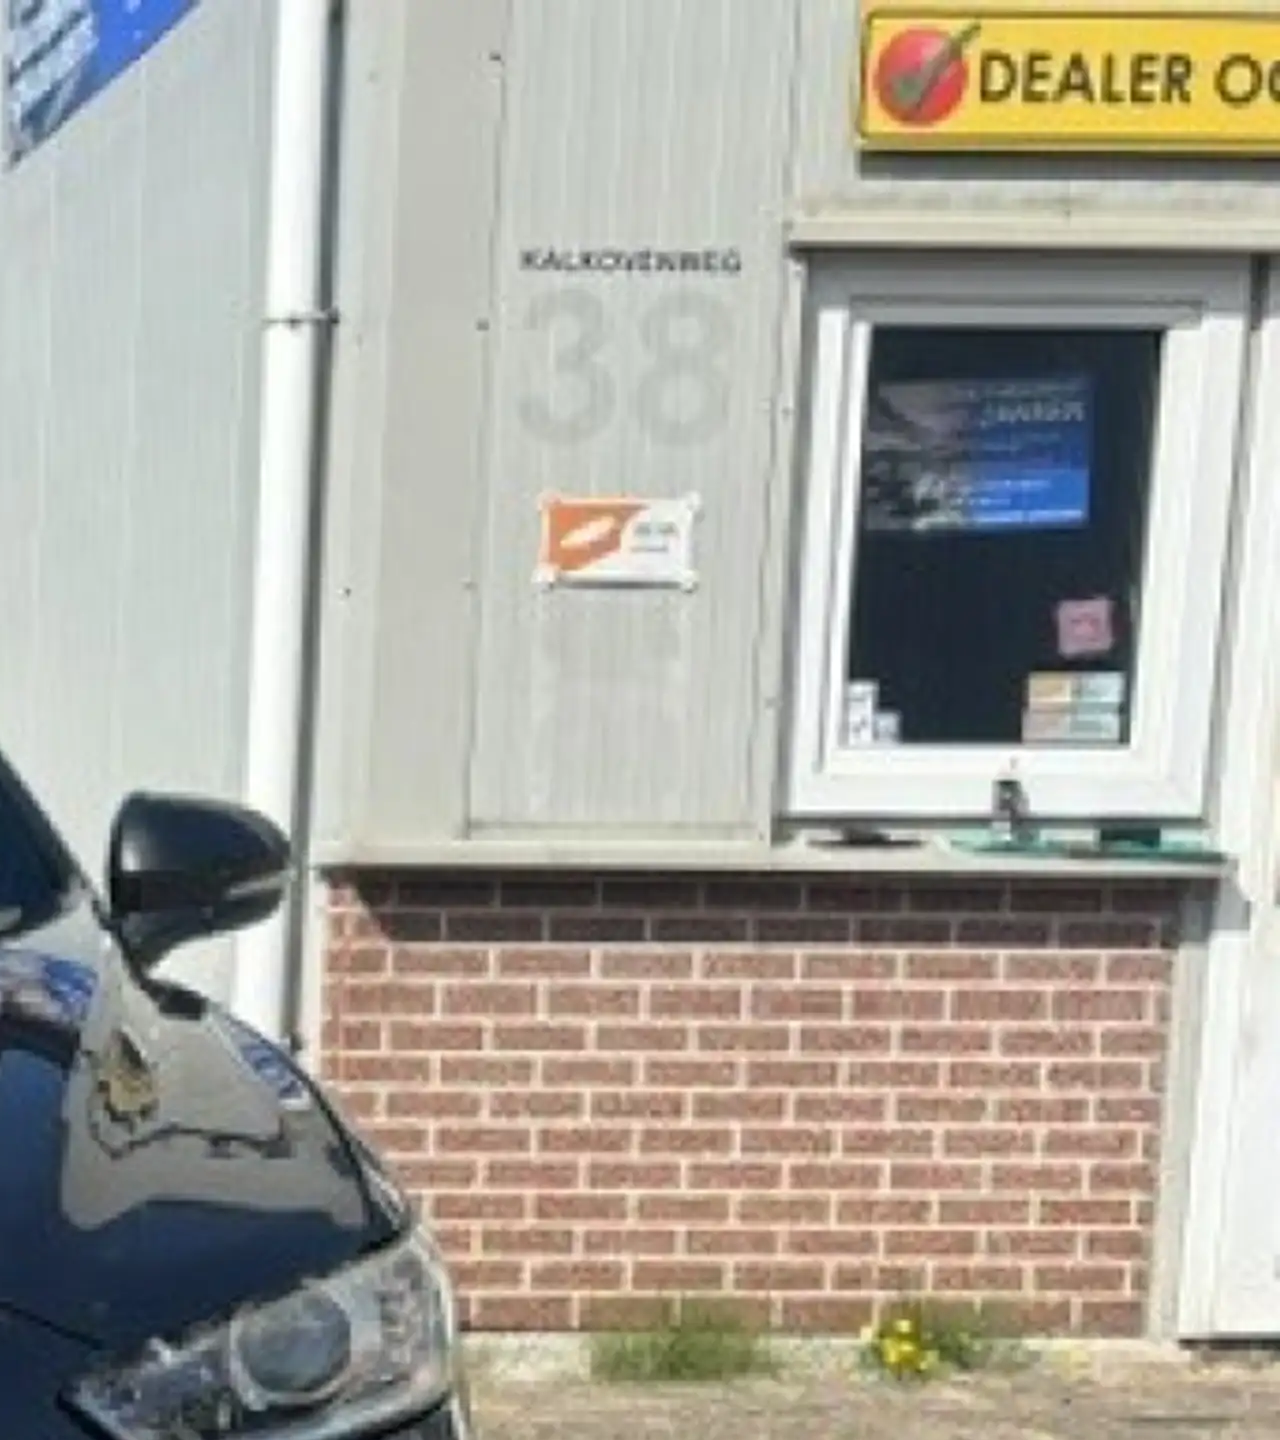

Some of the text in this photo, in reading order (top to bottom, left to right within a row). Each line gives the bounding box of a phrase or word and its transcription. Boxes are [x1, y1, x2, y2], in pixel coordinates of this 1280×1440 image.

[978, 50, 1280, 106] DEALER O
[518, 247, 742, 273] KALKOVENWEG
[516, 286, 738, 447] 38
